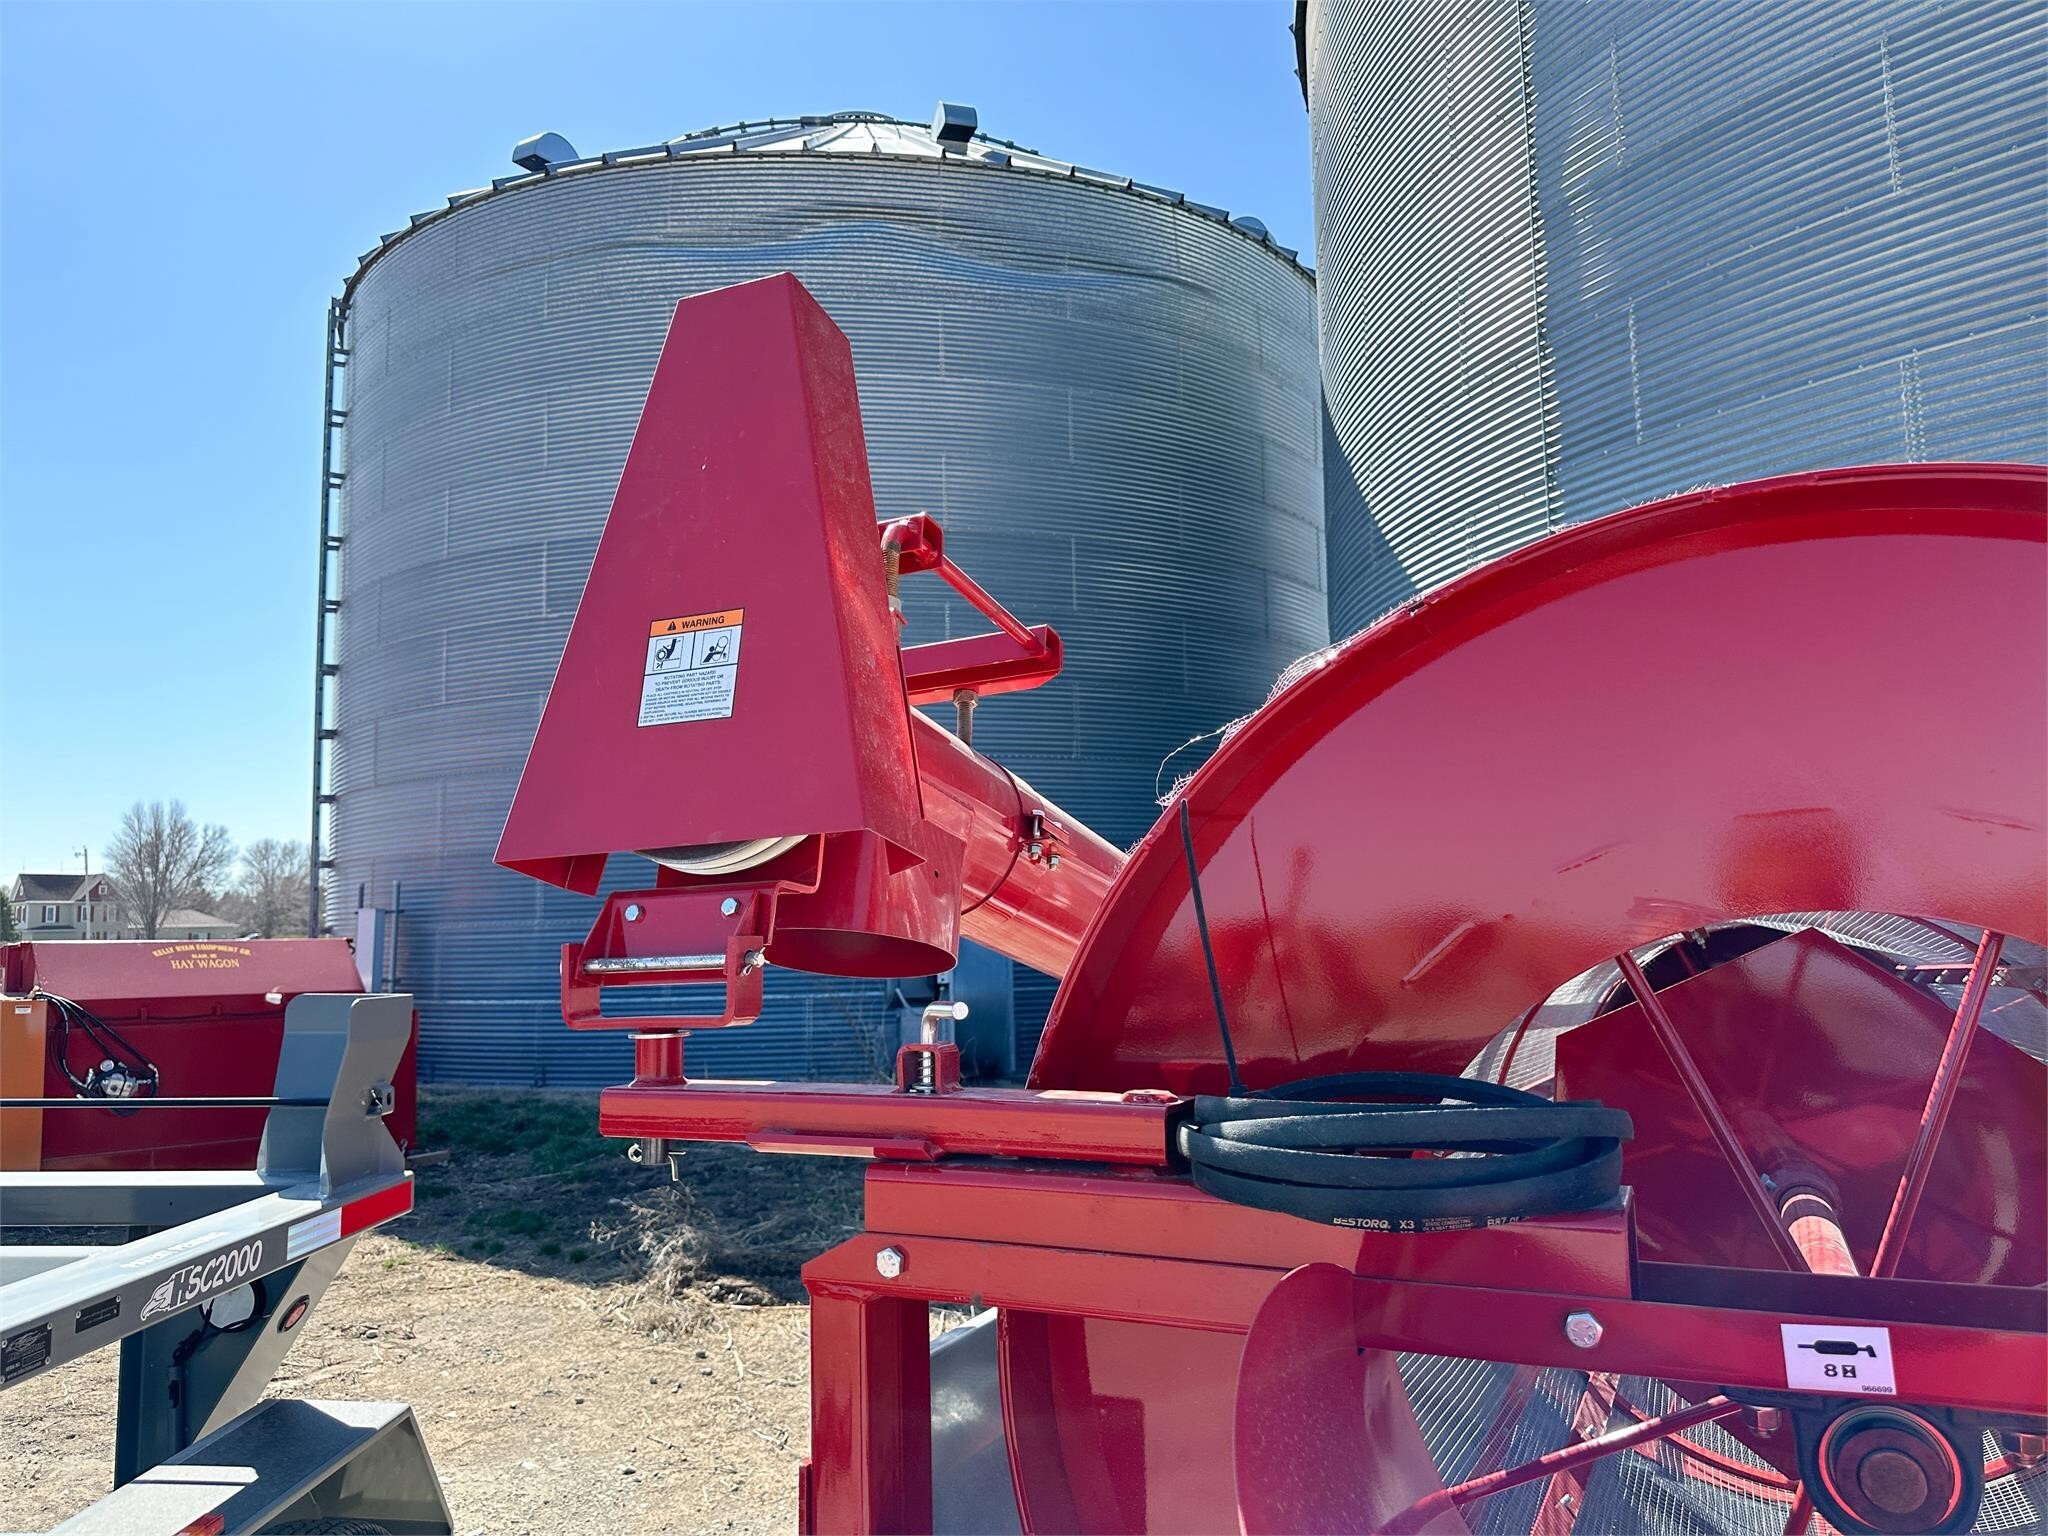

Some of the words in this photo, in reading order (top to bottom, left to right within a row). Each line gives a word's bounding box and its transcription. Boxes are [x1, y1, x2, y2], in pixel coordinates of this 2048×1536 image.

[681, 615, 725, 629] WARNING
[175, 944, 196, 952] RYAN
[196, 943, 239, 953] EQUIPMENT
[171, 960, 195, 969] HAY
[197, 958, 240, 969] WAGON
[1399, 1220, 1415, 1229] X3
[1824, 1363, 1838, 1377] 8
